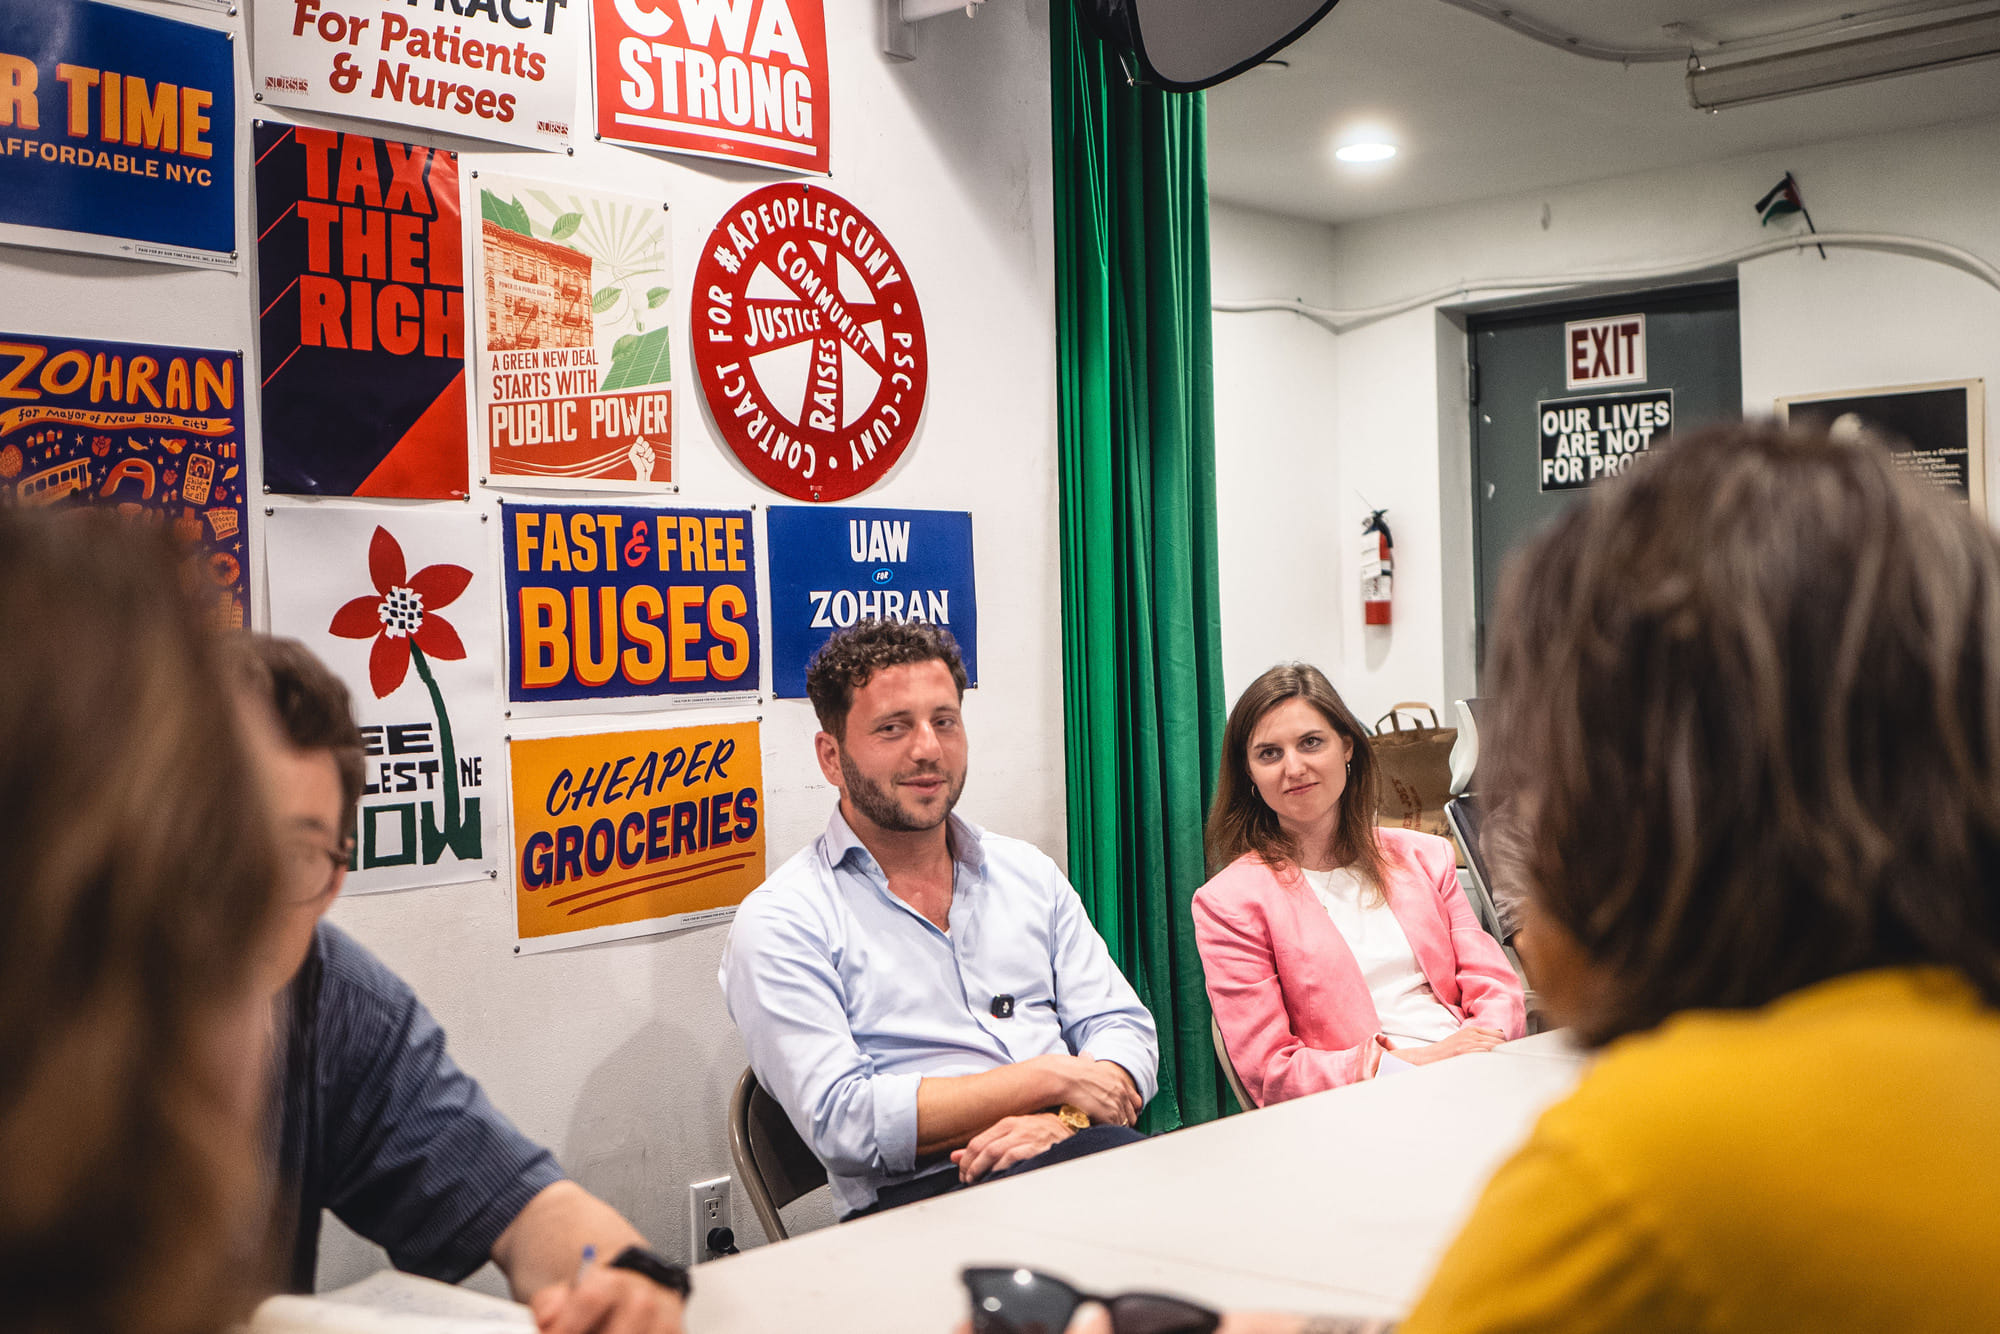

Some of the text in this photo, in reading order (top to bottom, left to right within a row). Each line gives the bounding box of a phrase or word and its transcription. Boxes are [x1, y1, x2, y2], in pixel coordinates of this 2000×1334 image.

[293, 0, 547, 81] For Patients
[56, 62, 213, 160] TIME
[264, 76, 309, 91] NURSES
[329, 52, 517, 123] & Nurses
[618, 36, 813, 139] STRONG
[166, 163, 213, 187] NYC
[295, 125, 433, 215] TAX
[297, 200, 426, 285] THE
[713, 197, 901, 290] #APEOPLESCUNY
[300, 274, 464, 359] RICH
[708, 285, 733, 342] FOR
[744, 304, 821, 347] JUSTICE
[777, 240, 872, 354] COMMUNITY
[0, 341, 235, 412] ZOHRAN
[492, 348, 598, 371] A GREEN NEW DEAL
[1571, 322, 1640, 381] EXIT
[492, 369, 597, 401] STARTS WITH
[809, 338, 837, 432] RAISES
[850, 332, 914, 472] PSC-CUNY
[90, 413, 100, 424] of
[104, 414, 136, 424] New
[491, 393, 669, 448] PUBLIC POWER
[716, 362, 816, 479] CONTRACT
[1542, 400, 1671, 437] OUR LIVES
[1555, 426, 1654, 458] ARE NOT
[1542, 452, 1648, 485] FOR PRO
[515, 512, 747, 572] FAST & FREE
[849, 519, 911, 563] UAW
[876, 571, 889, 581] FOR
[518, 584, 750, 689] BUSES
[809, 589, 950, 629] ZOHRAN
[358, 722, 434, 756] EE
[545, 738, 736, 817] CHEAPER
[346, 797, 483, 871] OW
[521, 787, 758, 892] GROCERIES
